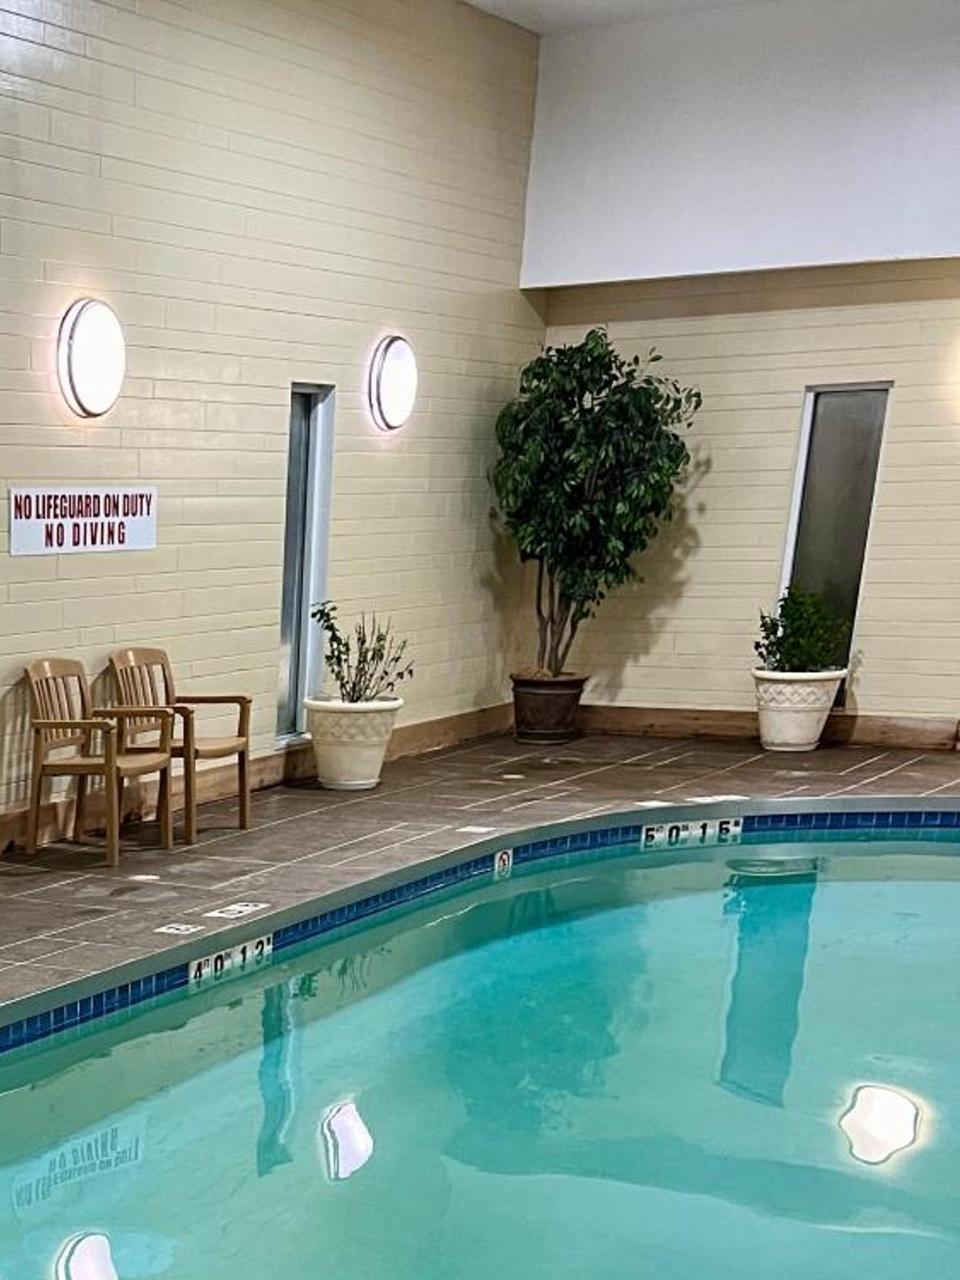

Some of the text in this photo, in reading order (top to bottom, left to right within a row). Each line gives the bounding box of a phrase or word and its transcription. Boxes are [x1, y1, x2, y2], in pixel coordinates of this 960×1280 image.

[14, 493, 152, 519] NO LIFEGUARD ON DUTY
[45, 521, 126, 547] NO DIVING
